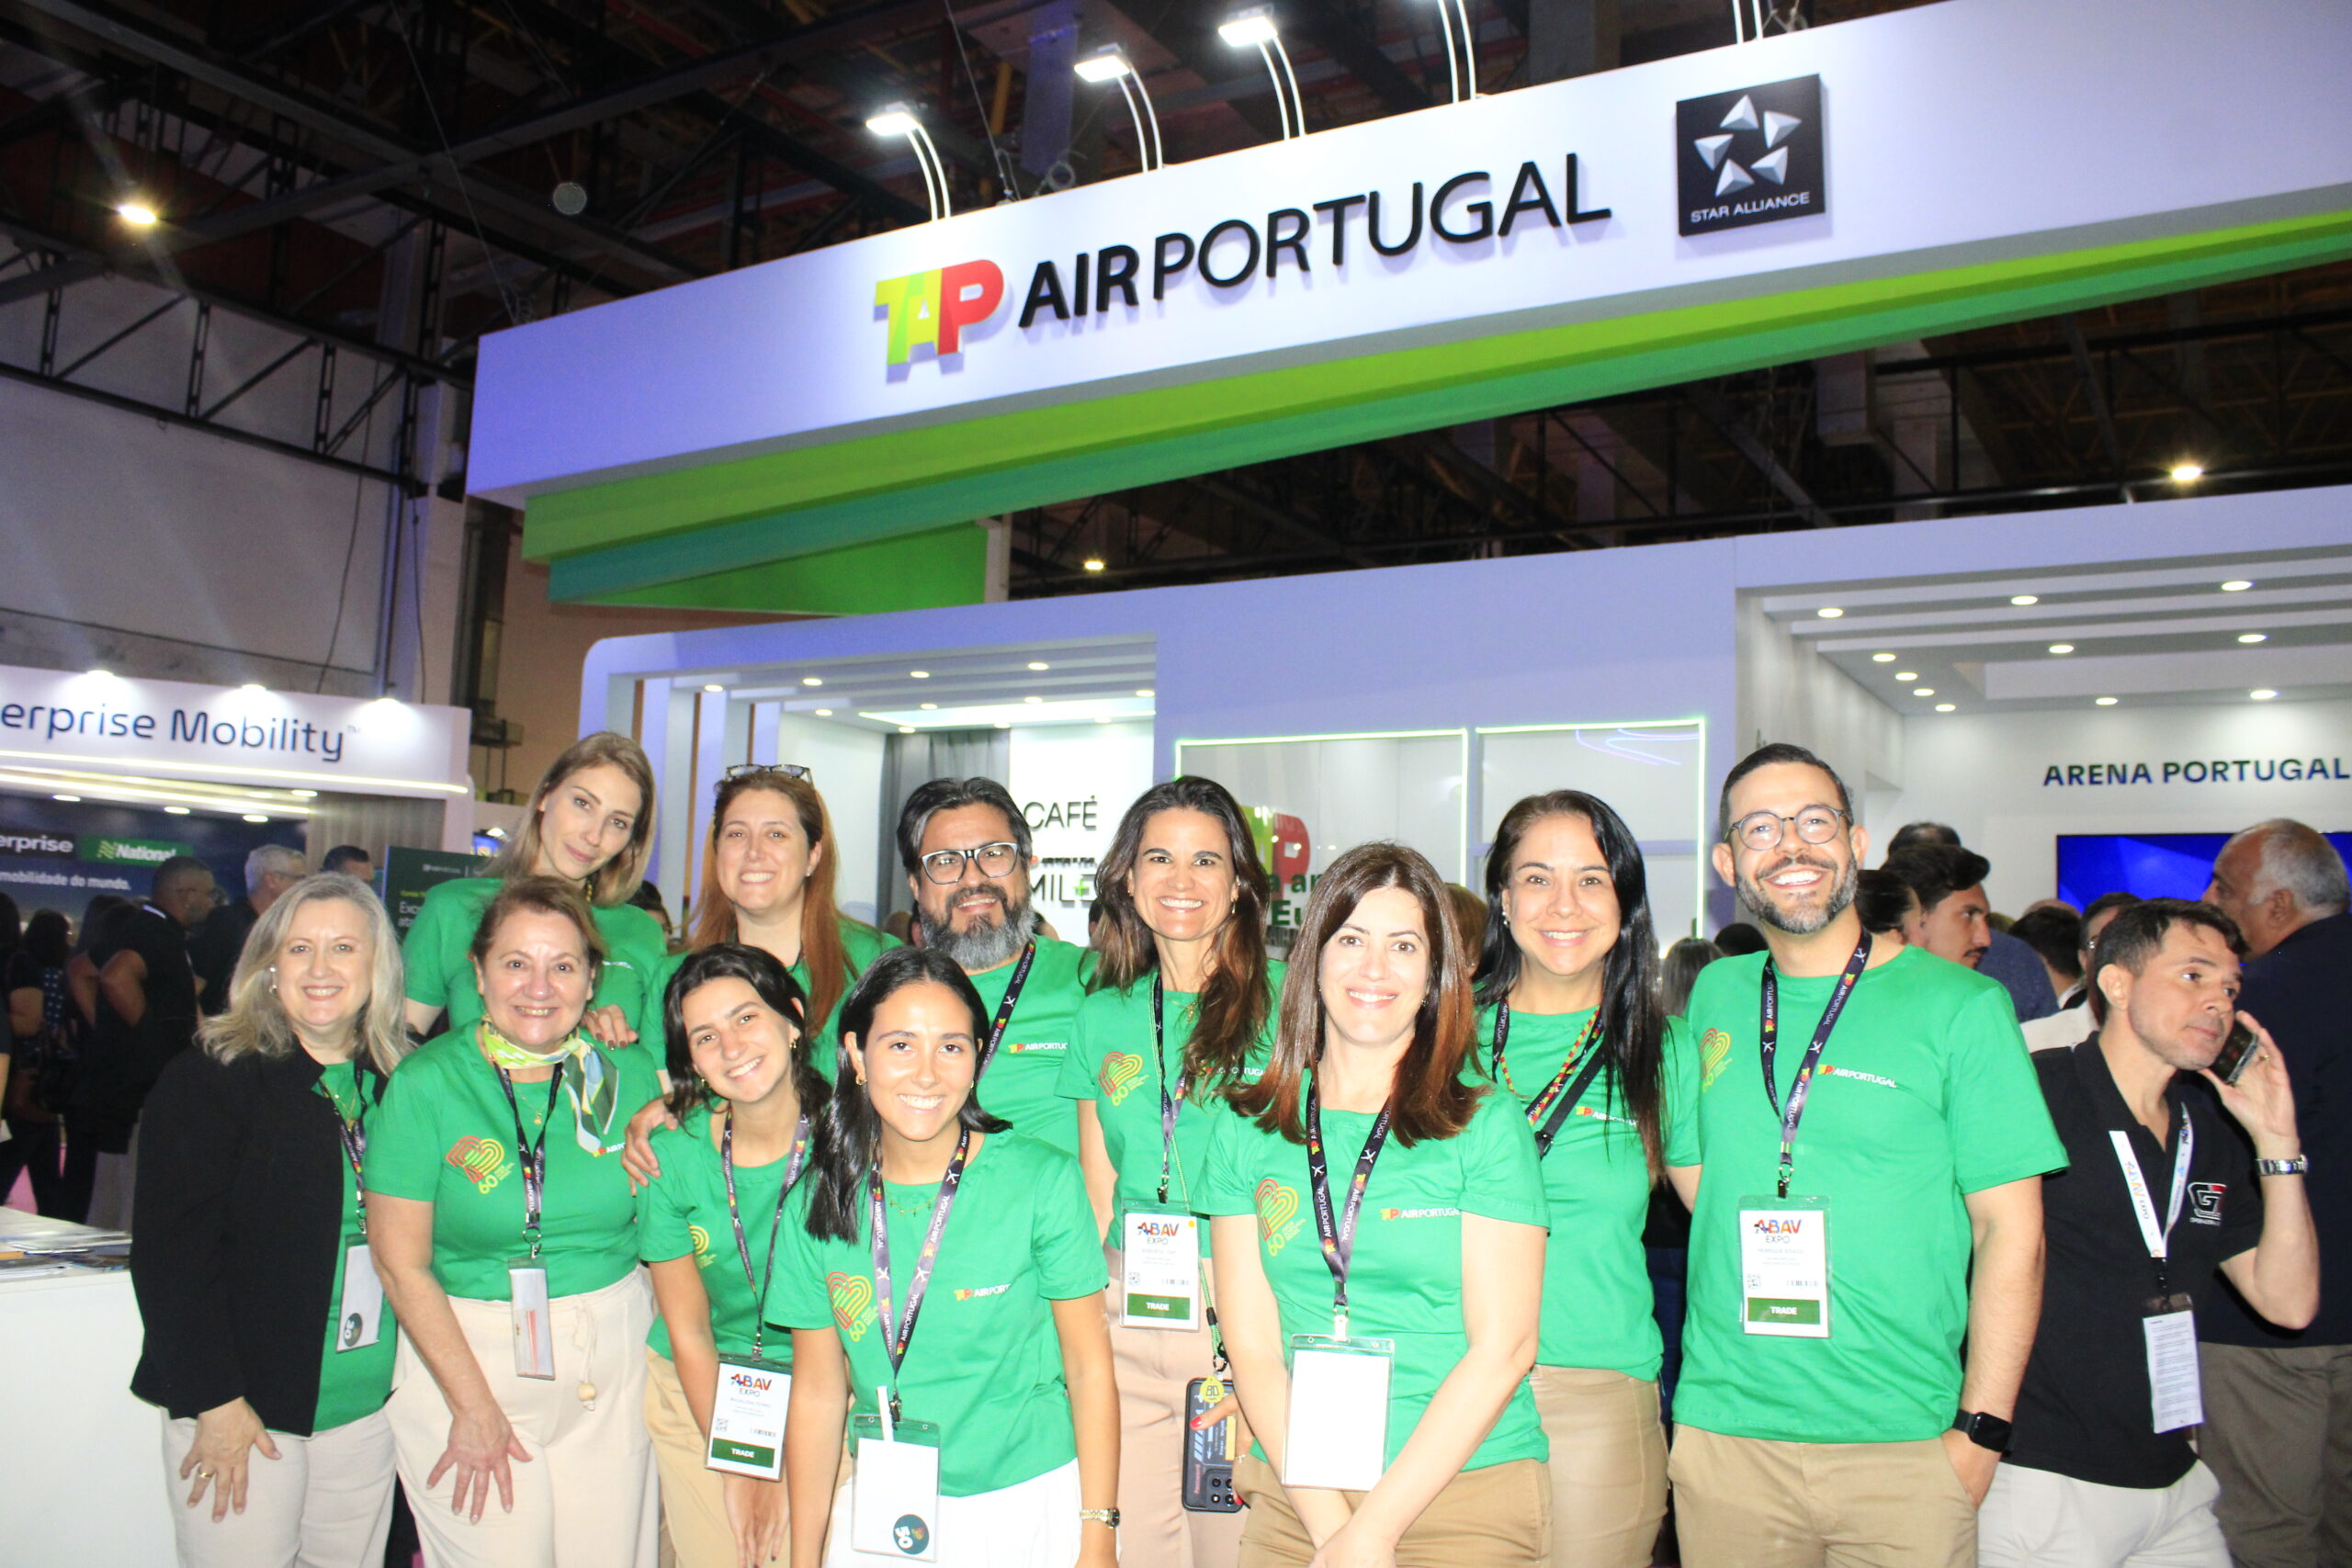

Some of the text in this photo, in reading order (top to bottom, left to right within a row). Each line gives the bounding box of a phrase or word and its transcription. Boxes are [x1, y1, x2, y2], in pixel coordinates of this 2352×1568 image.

[1690, 191, 1810, 223] STAR ALLIANCE
[874, 259, 1003, 367] TAP
[1, 703, 156, 739] erprise
[170, 708, 344, 763] Mobility
[2043, 757, 2350, 786] ARENA PORTUGAL
[1023, 795, 1097, 829] CAFÉ
[1770, 1306, 1798, 1315] TRADE
